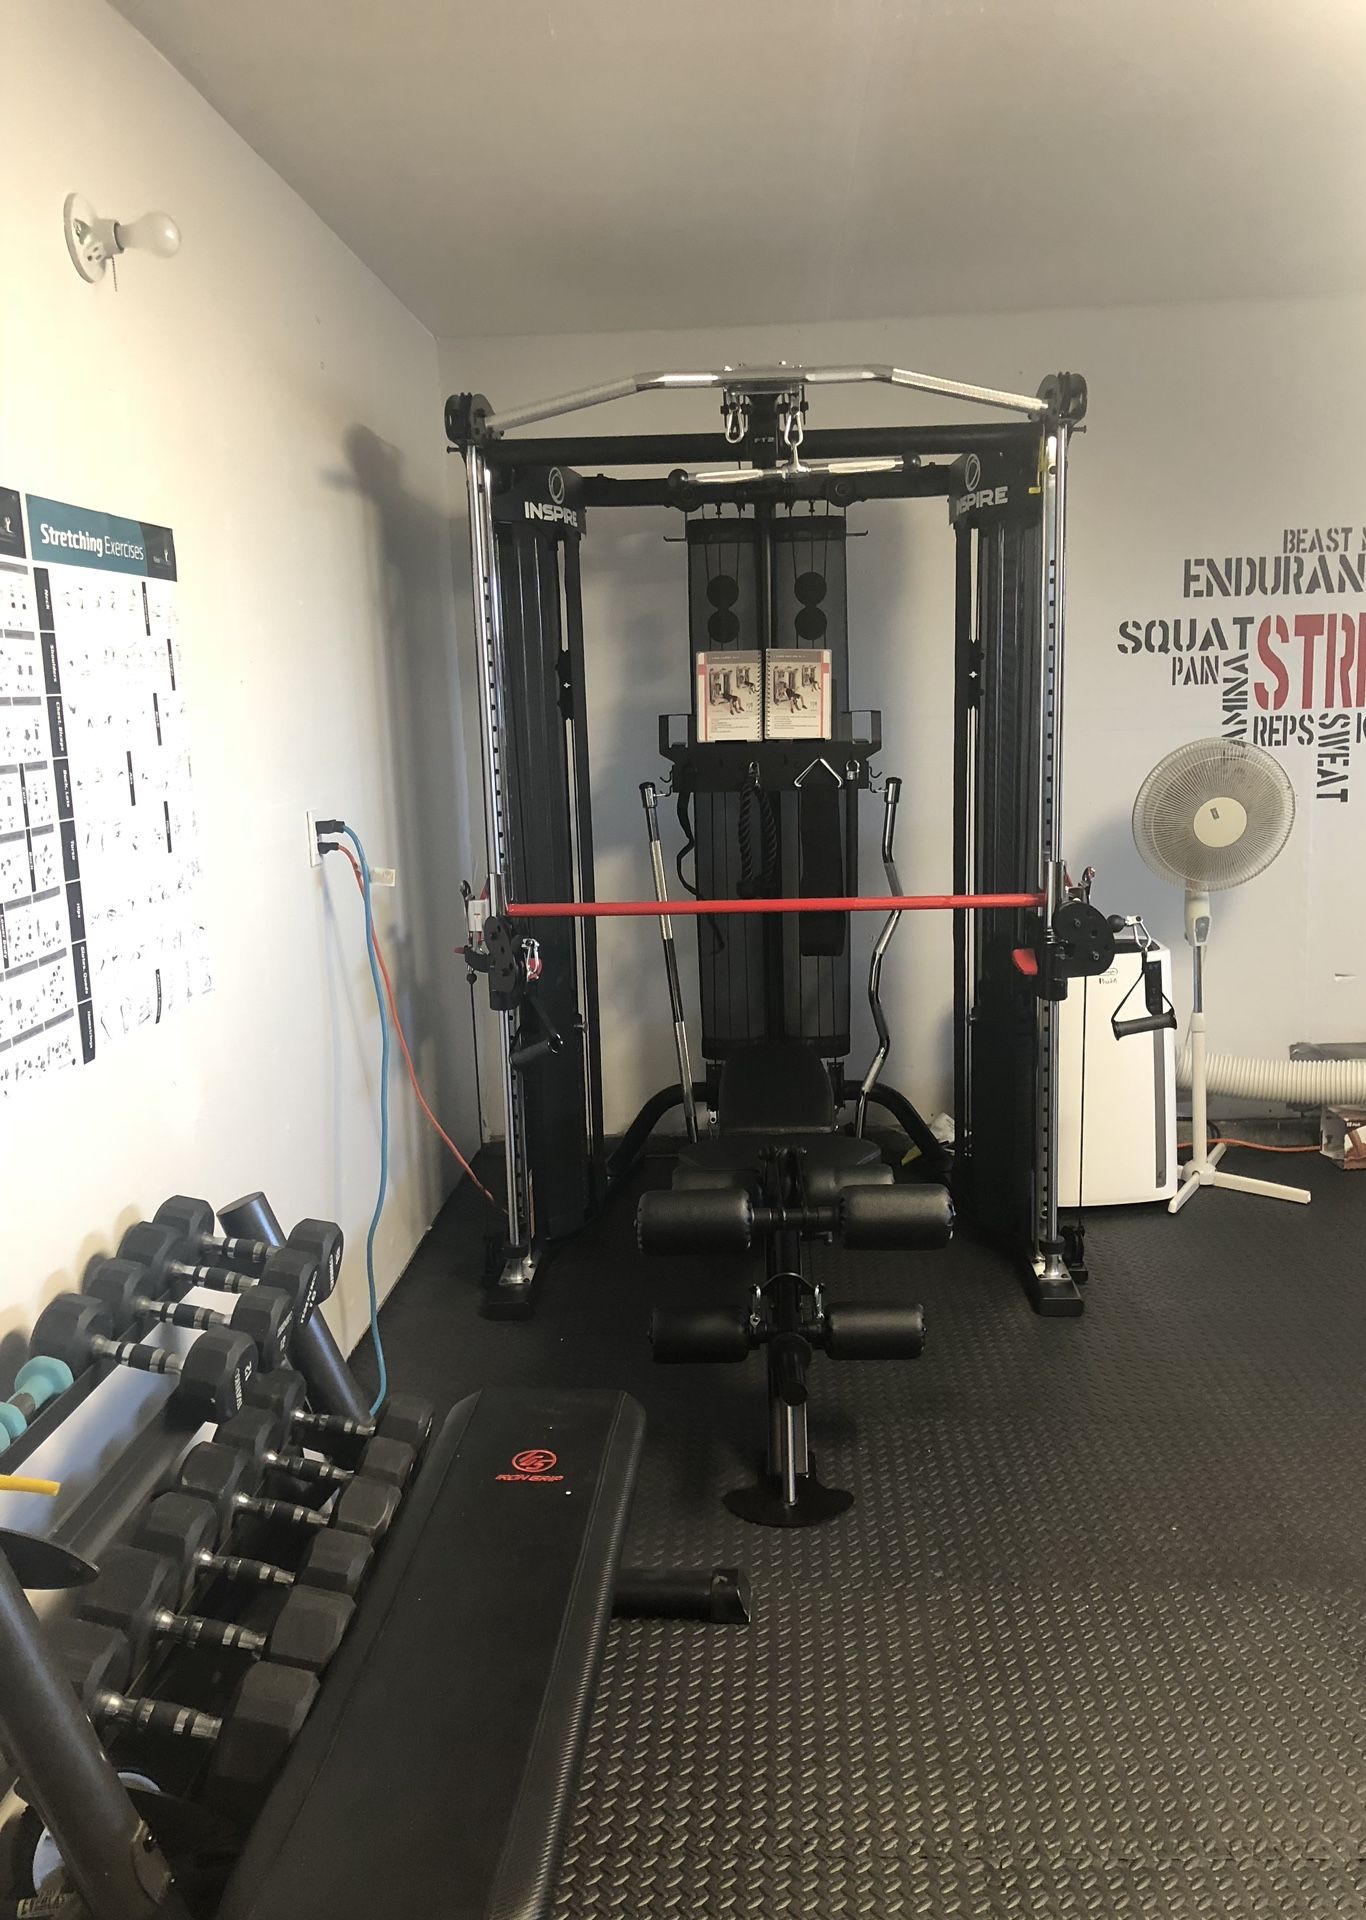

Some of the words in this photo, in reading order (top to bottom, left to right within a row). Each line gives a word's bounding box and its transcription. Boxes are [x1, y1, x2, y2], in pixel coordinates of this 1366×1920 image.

[40, 523, 103, 557] Stretching
[104, 535, 144, 560] Exercises
[1283, 527, 1353, 553] BEAST
[1117, 616, 1254, 654] SQUAT
[50, 645, 58, 682] Shoulders
[1171, 655, 1219, 686] PAIN
[1253, 714, 1314, 747] REPS
[1316, 712, 1350, 803] SWEAT
[244, 1361, 252, 1382] 12
